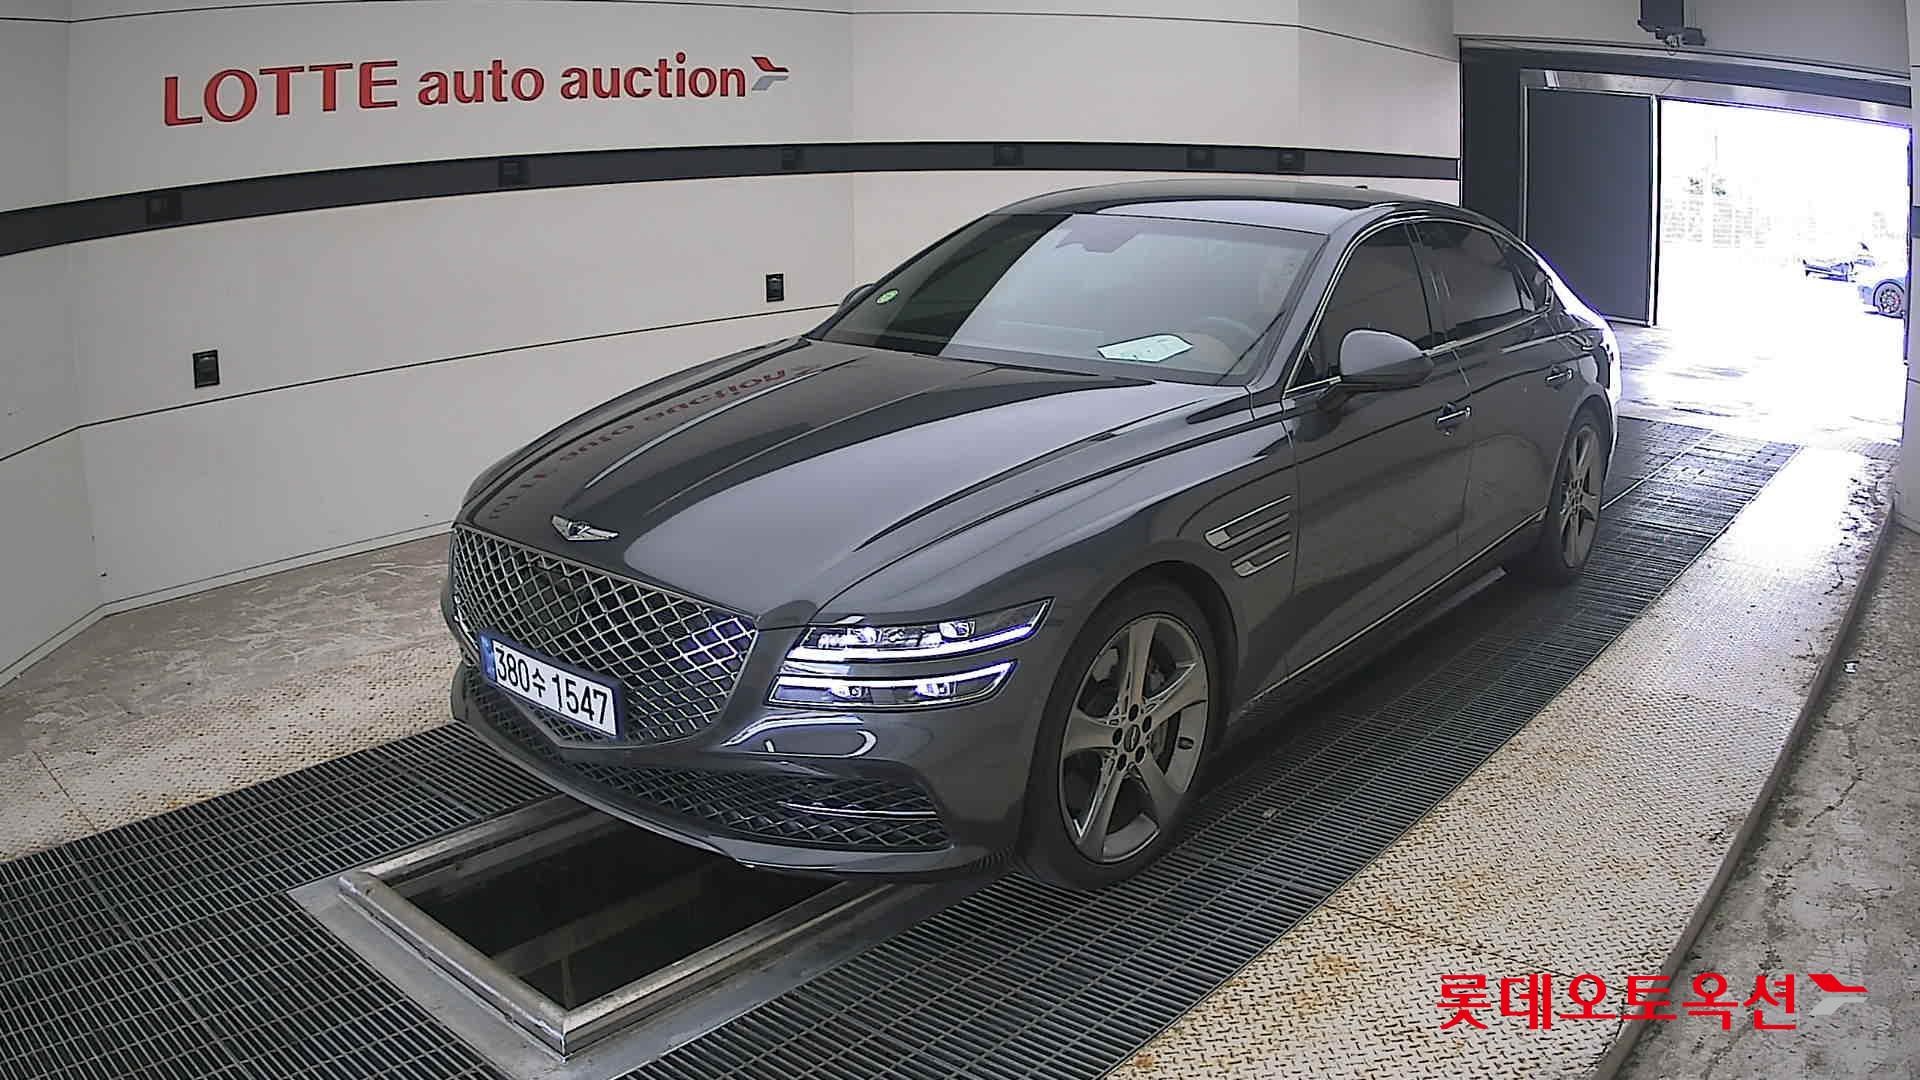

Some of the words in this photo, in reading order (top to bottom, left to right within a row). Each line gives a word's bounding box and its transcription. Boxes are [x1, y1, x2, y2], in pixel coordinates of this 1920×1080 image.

[164, 60, 398, 126] LOTTE
[417, 59, 545, 105] auto
[560, 52, 747, 99] auction
[495, 647, 546, 698] 380수
[551, 672, 608, 725] 1547
